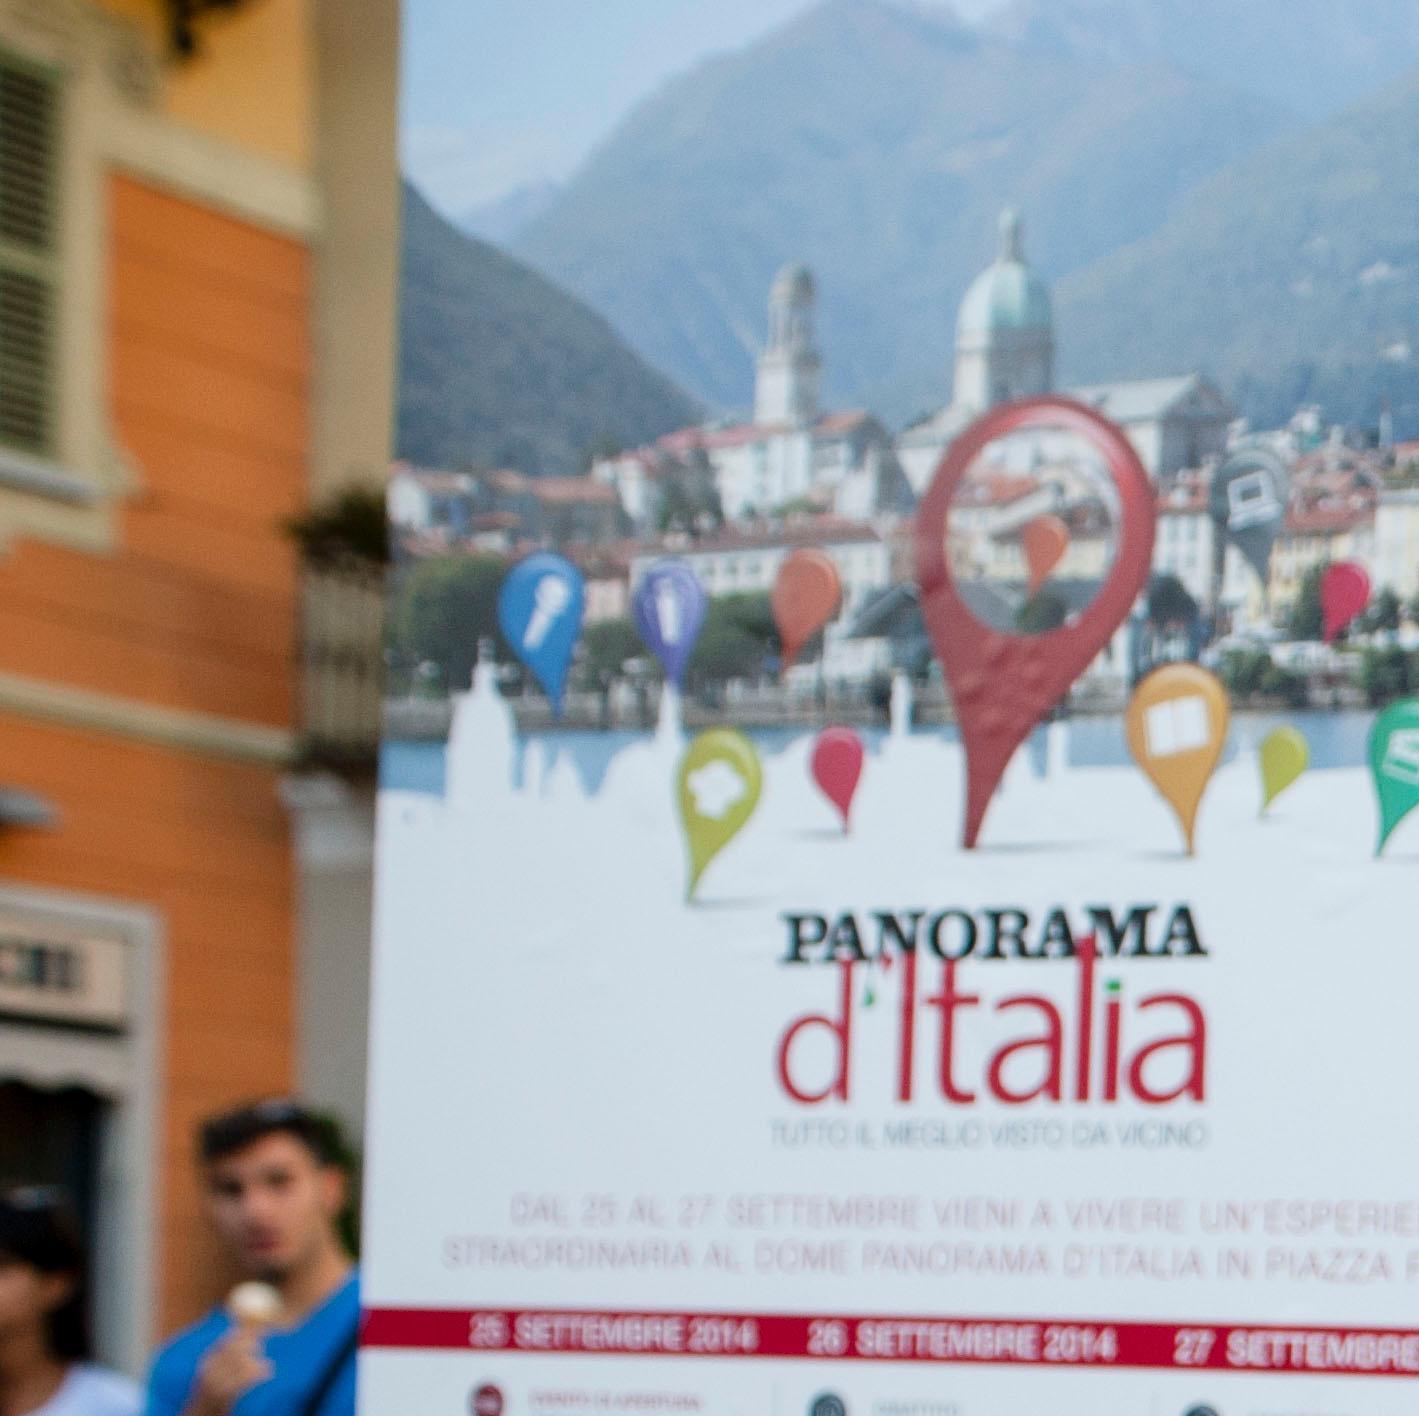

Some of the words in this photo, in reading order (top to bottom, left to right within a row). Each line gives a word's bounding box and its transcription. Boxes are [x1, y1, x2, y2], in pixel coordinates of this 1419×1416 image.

[780, 903, 1208, 964] PANORAMA
[775, 934, 1207, 1106] d'Italia
[510, 1193, 568, 1226] DAL
[580, 1194, 618, 1226] 25
[626, 1194, 665, 1227] AL
[677, 1194, 713, 1228] 27
[724, 1195, 922, 1230] SETTEMBRE
[933, 1196, 1018, 1231] VIENI
[1030, 1198, 1052, 1231] A
[1064, 1199, 1187, 1233] VIVERE
[441, 1234, 693, 1273] STRAORDINARIA
[701, 1238, 741, 1274] AL
[751, 1239, 851, 1275] DOME
[861, 1241, 1051, 1277] PANORAMA
[1062, 1244, 1202, 1279] D'ITALIA
[1216, 1247, 1252, 1281] IN
[1264, 1248, 1392, 1283] PIAZZA
[468, 1313, 509, 1348] 25
[514, 1314, 684, 1351] SETTEMBRE
[688, 1318, 760, 1352] 2014
[806, 1319, 847, 1354] 26
[855, 1320, 1040, 1361] SETTEMBRE
[1043, 1325, 1117, 1362] 2014
[1173, 1329, 1216, 1363] 27
